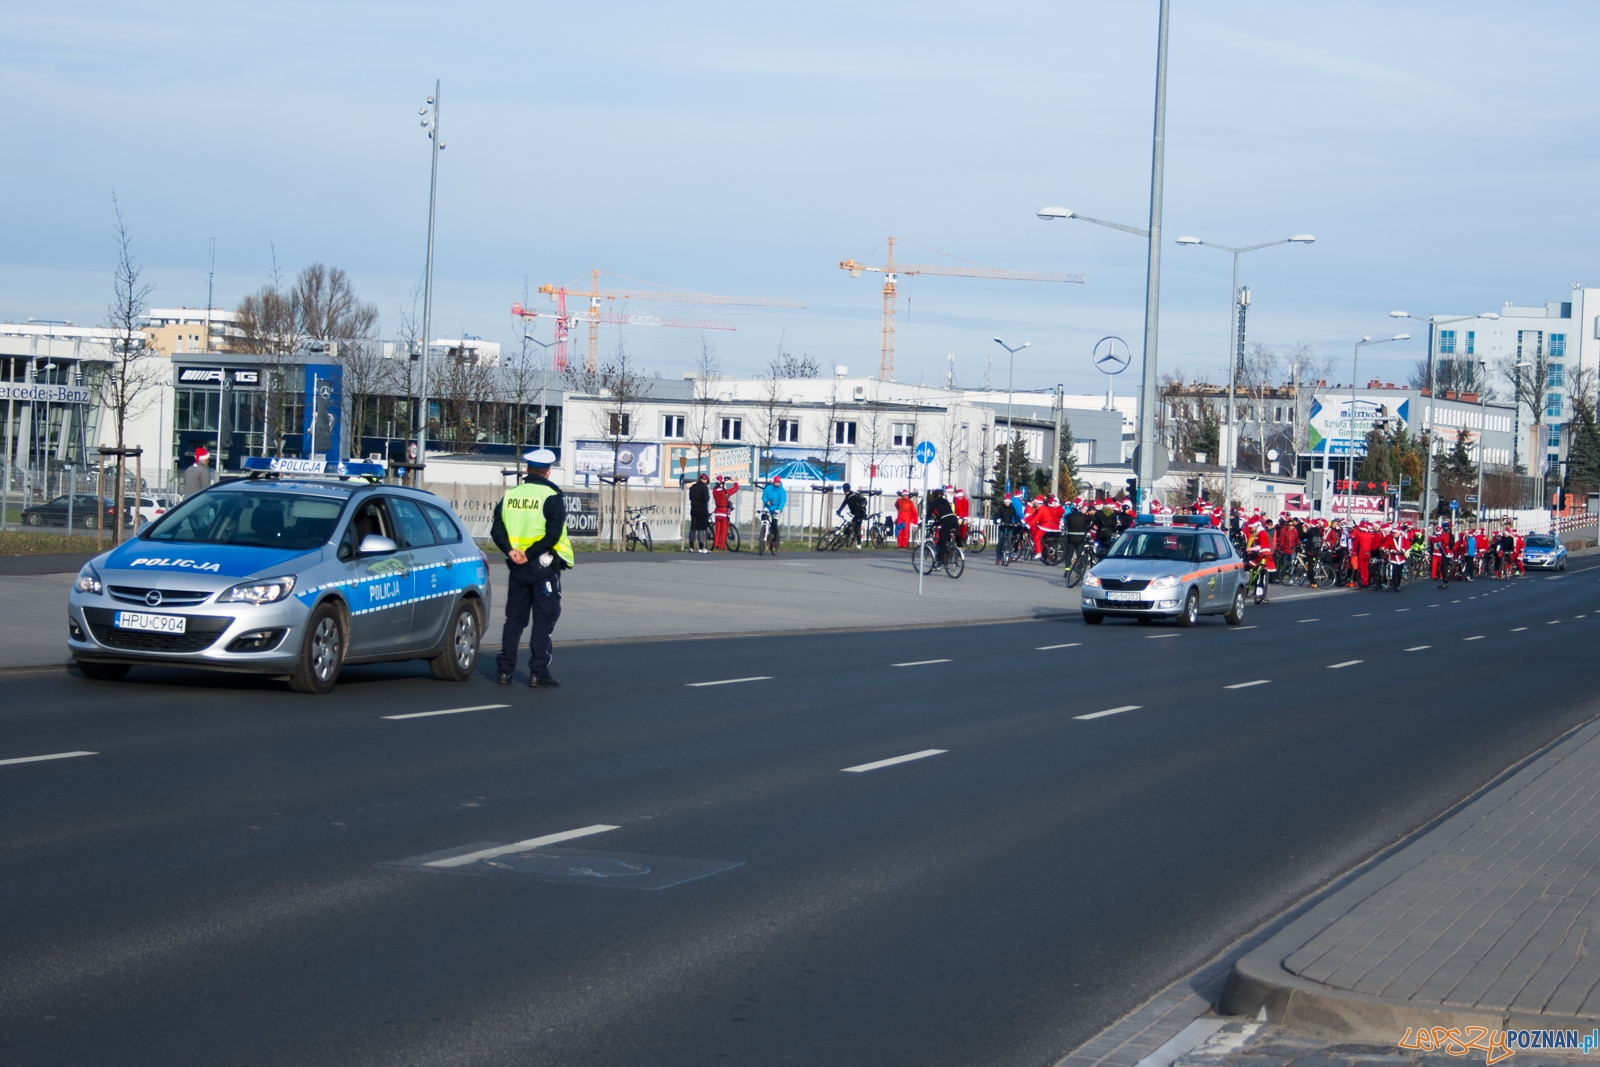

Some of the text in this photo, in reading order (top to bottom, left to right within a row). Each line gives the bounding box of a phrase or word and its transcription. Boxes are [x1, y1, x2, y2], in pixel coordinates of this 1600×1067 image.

[279, 460, 321, 473] POLICJA
[507, 498, 540, 511] POLICJA
[130, 558, 220, 572] POLICJA
[369, 580, 401, 602] POLICJA
[122, 614, 184, 632] HPU C904
